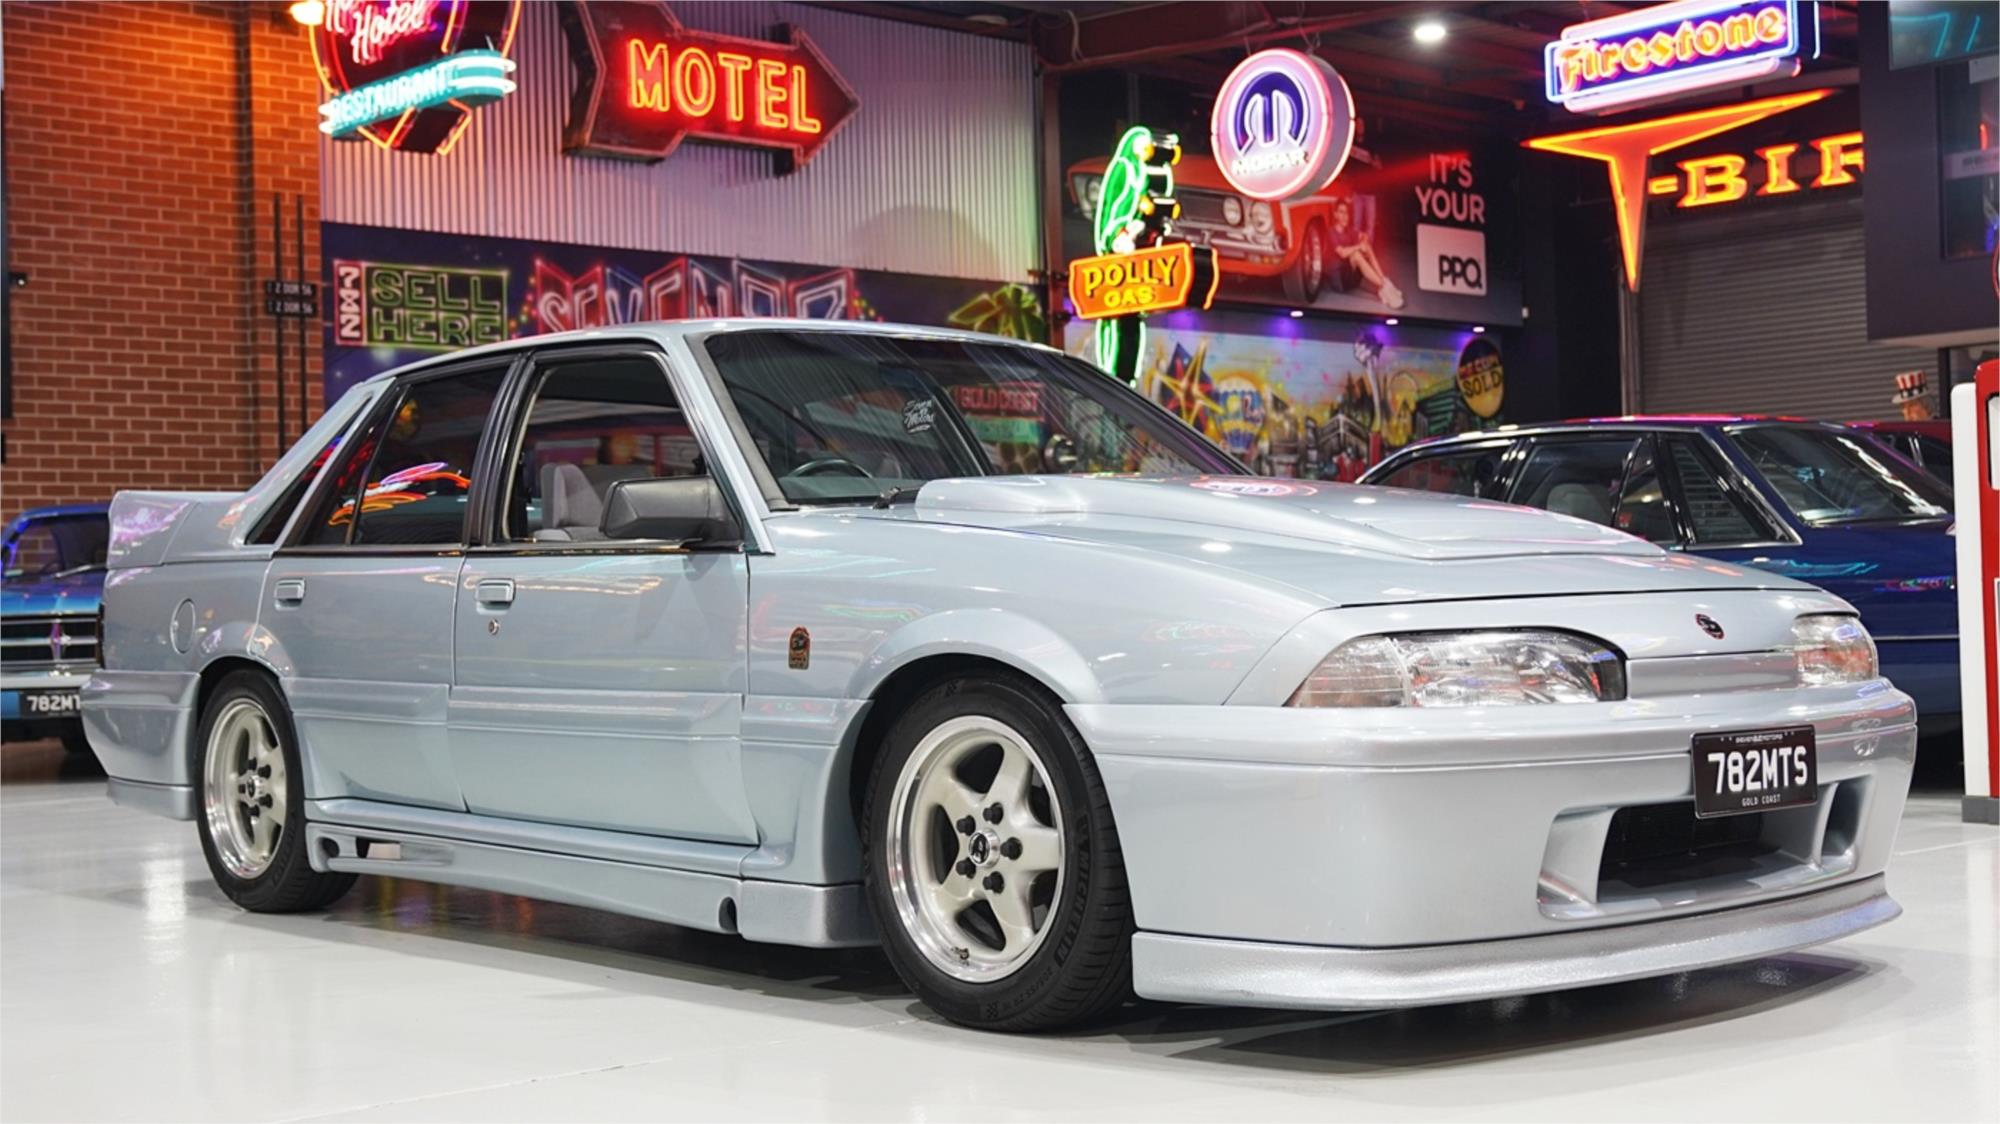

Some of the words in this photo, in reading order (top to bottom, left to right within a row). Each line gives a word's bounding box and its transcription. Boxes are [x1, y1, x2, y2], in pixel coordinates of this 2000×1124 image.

[350, 0, 424, 63] Hotel
[1558, 8, 1788, 94] Firestone
[330, 62, 452, 128] RESTAURANT
[628, 38, 821, 133] MOTEL
[1232, 149, 1309, 176] MOPAR
[1429, 153, 1472, 186] IT'S
[1416, 186, 1485, 224] YOUR
[371, 268, 500, 313] SELL
[1081, 254, 1178, 297] POLLY
[1439, 254, 1483, 290] PPQ
[1103, 283, 1158, 307] GAS
[371, 307, 500, 346] HERE
[1462, 370, 1502, 399] SOLD
[1707, 745, 1808, 795] 782MTS
[1742, 797, 1758, 807] GOLD
[1761, 794, 1781, 805] COAST
[1057, 848, 1090, 960] MICHELIN
